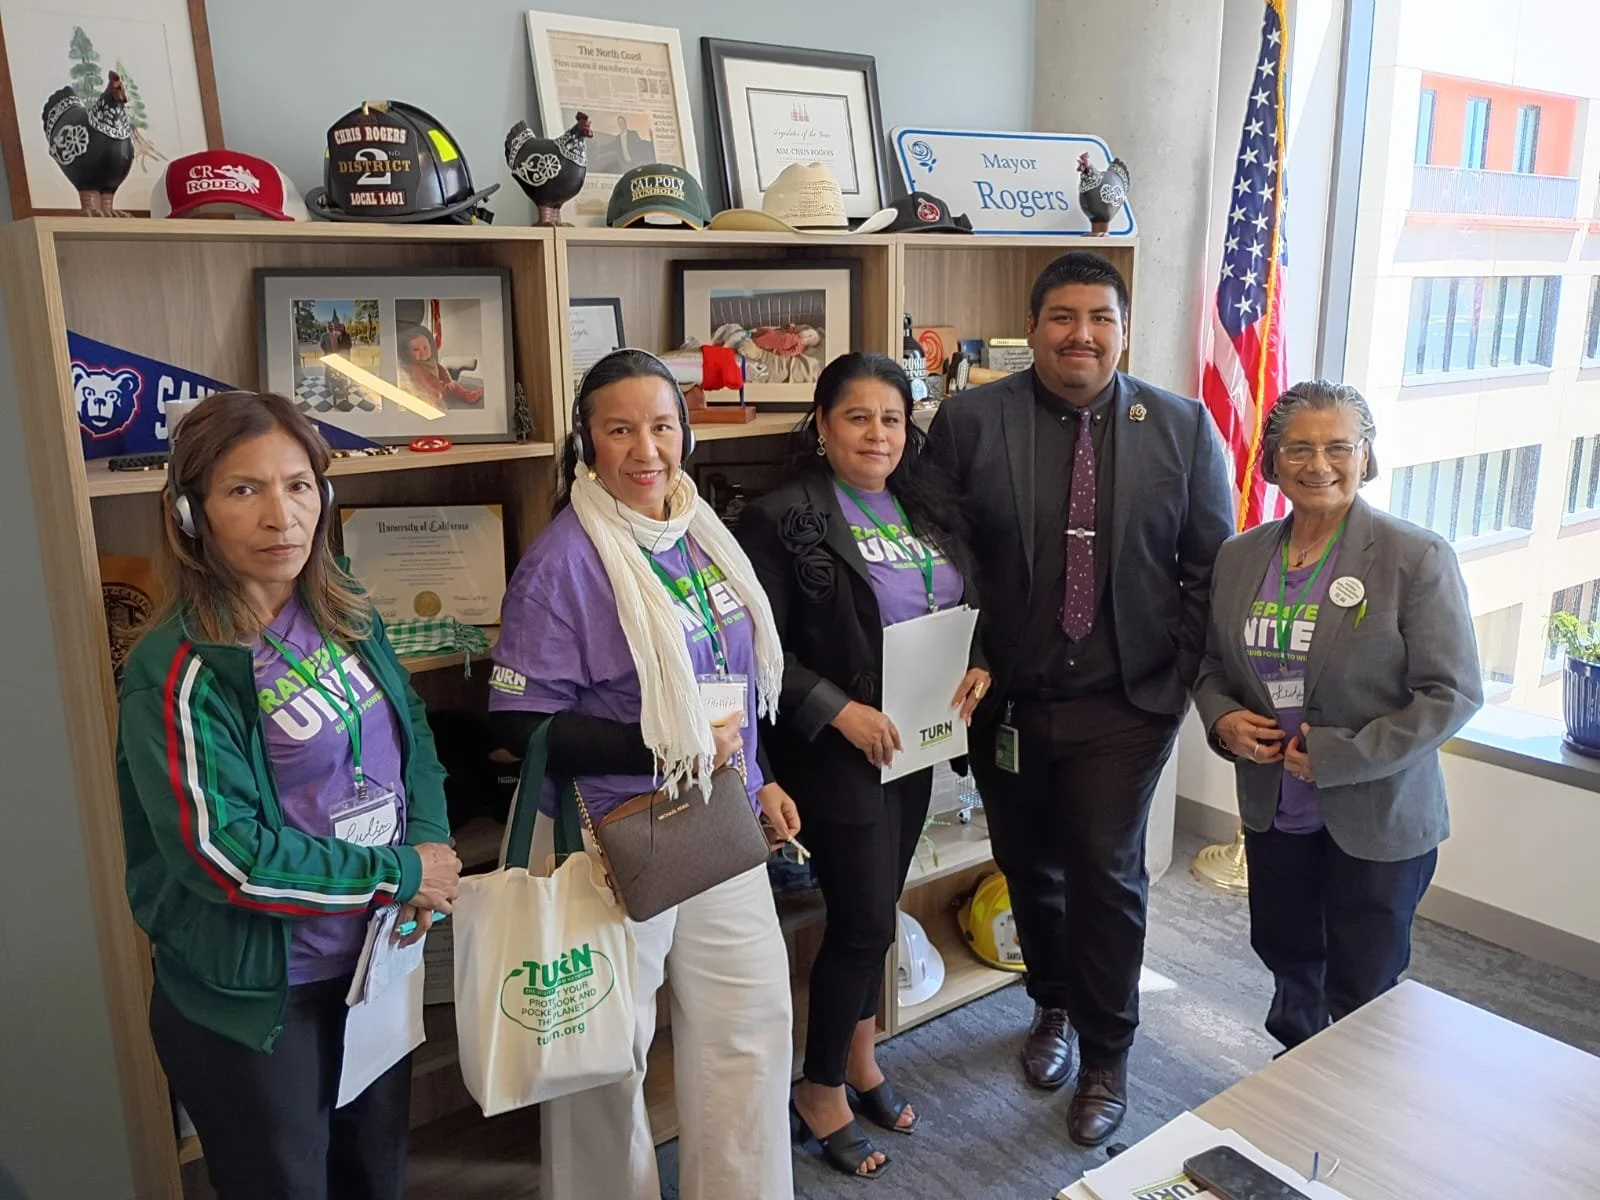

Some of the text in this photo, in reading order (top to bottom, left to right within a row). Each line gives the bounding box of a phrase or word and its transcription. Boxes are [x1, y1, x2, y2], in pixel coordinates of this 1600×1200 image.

[577, 45, 642, 61] The North Coast
[553, 58, 570, 68] New
[571, 60, 597, 71] council
[630, 66, 645, 76] take
[334, 126, 407, 145] CHRIS ROGERS
[338, 159, 411, 173] DISTRICT
[355, 148, 391, 185] 2
[981, 153, 1038, 173] Mayor
[189, 165, 214, 178] CR
[186, 179, 249, 194] RODEO
[631, 176, 685, 192] CAL POLY
[350, 191, 404, 206] LOCAL 1401
[973, 180, 1069, 218] Rogers
[376, 520, 419, 534] University
[492, 665, 527, 687] TURN
[919, 720, 953, 742] TURN
[563, 981, 588, 995] YOUR
[579, 988, 597, 1001] AND
